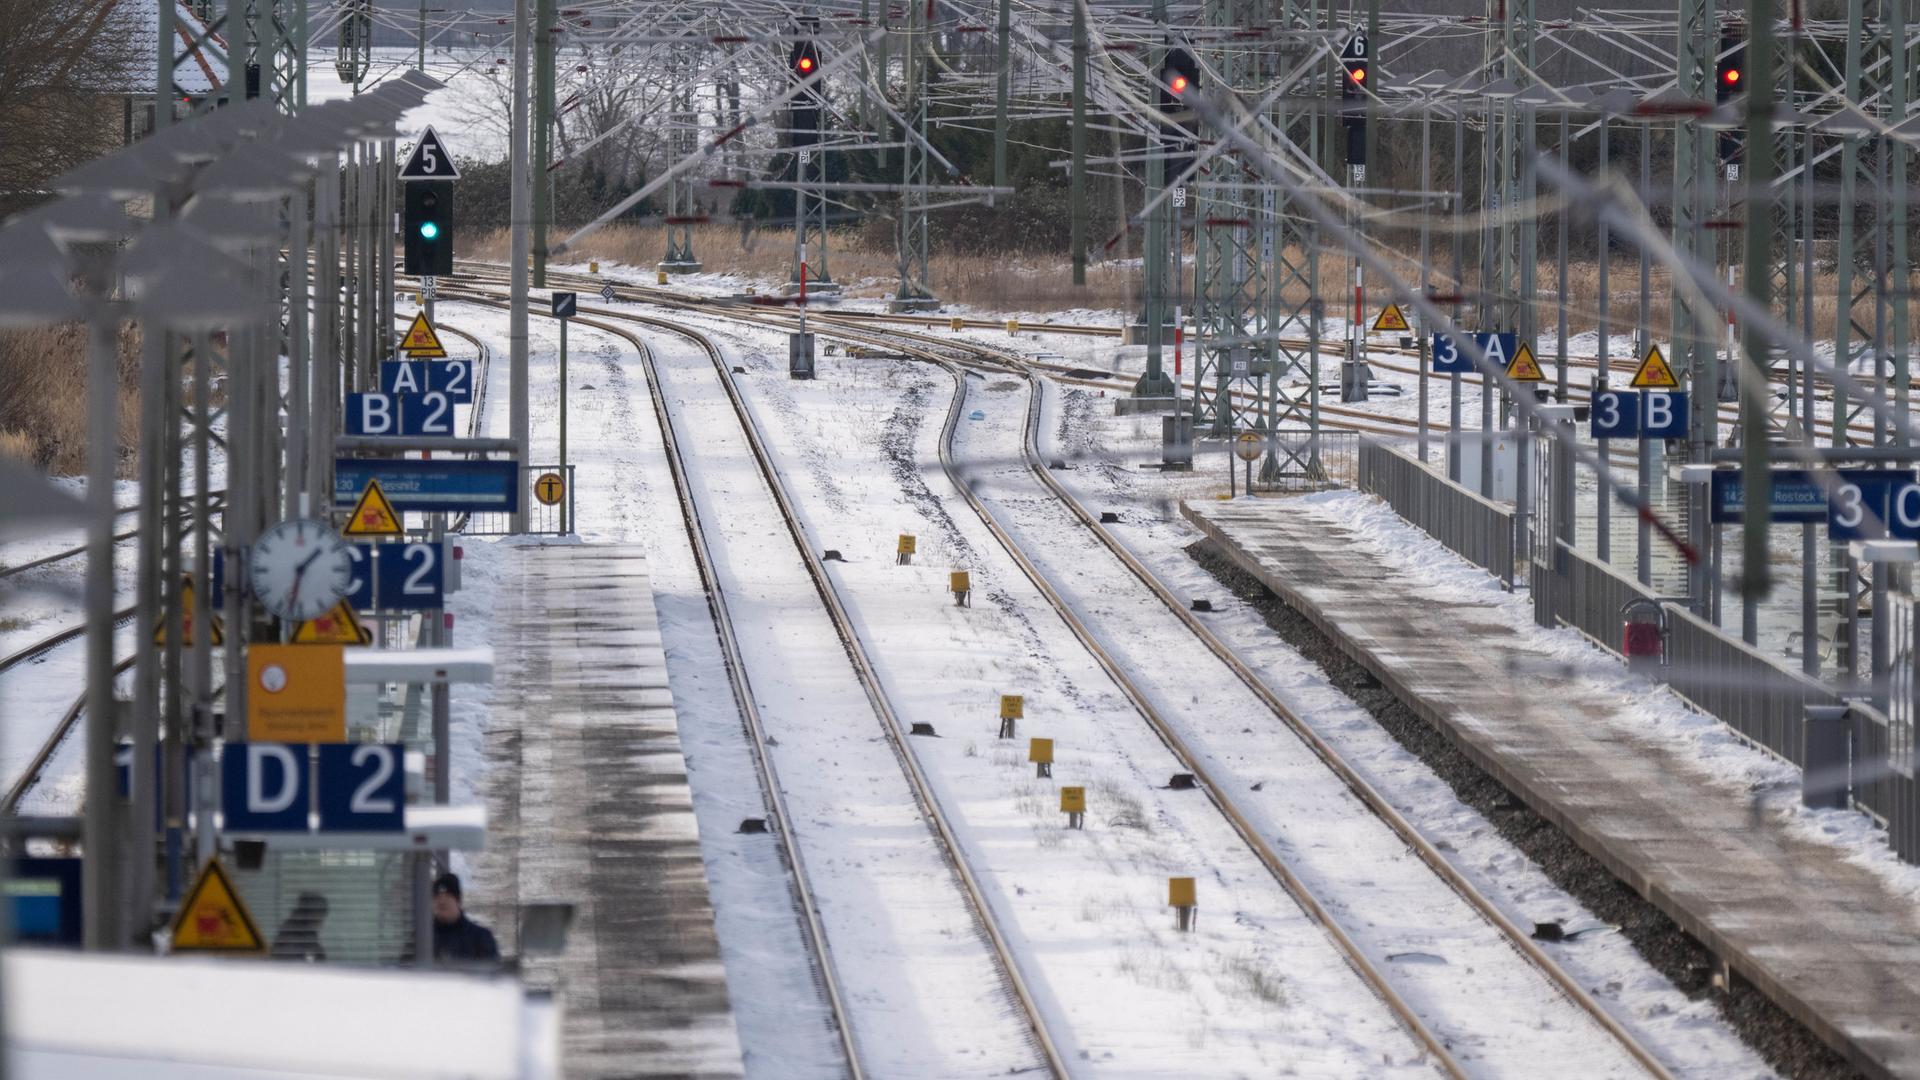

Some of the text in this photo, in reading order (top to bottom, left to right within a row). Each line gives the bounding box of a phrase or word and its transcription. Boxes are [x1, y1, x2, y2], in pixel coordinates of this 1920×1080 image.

[1354, 36, 1364, 56] 6
[422, 144, 437, 174] 5
[800, 155, 809, 163] P1
[1174, 197, 1185, 207] P2
[1175, 188, 1184, 197] 13
[421, 287, 436, 299] P18
[424, 276, 434, 287] 13
[1438, 334, 1506, 364] 3 A
[392, 361, 467, 394] A 2
[362, 392, 448, 433] B 2
[1598, 393, 1673, 428] 3 B
[1775, 491, 1816, 502] Rostock
[1836, 484, 1863, 528] 3
[403, 545, 436, 595] 2
[247, 746, 396, 813] D 2
